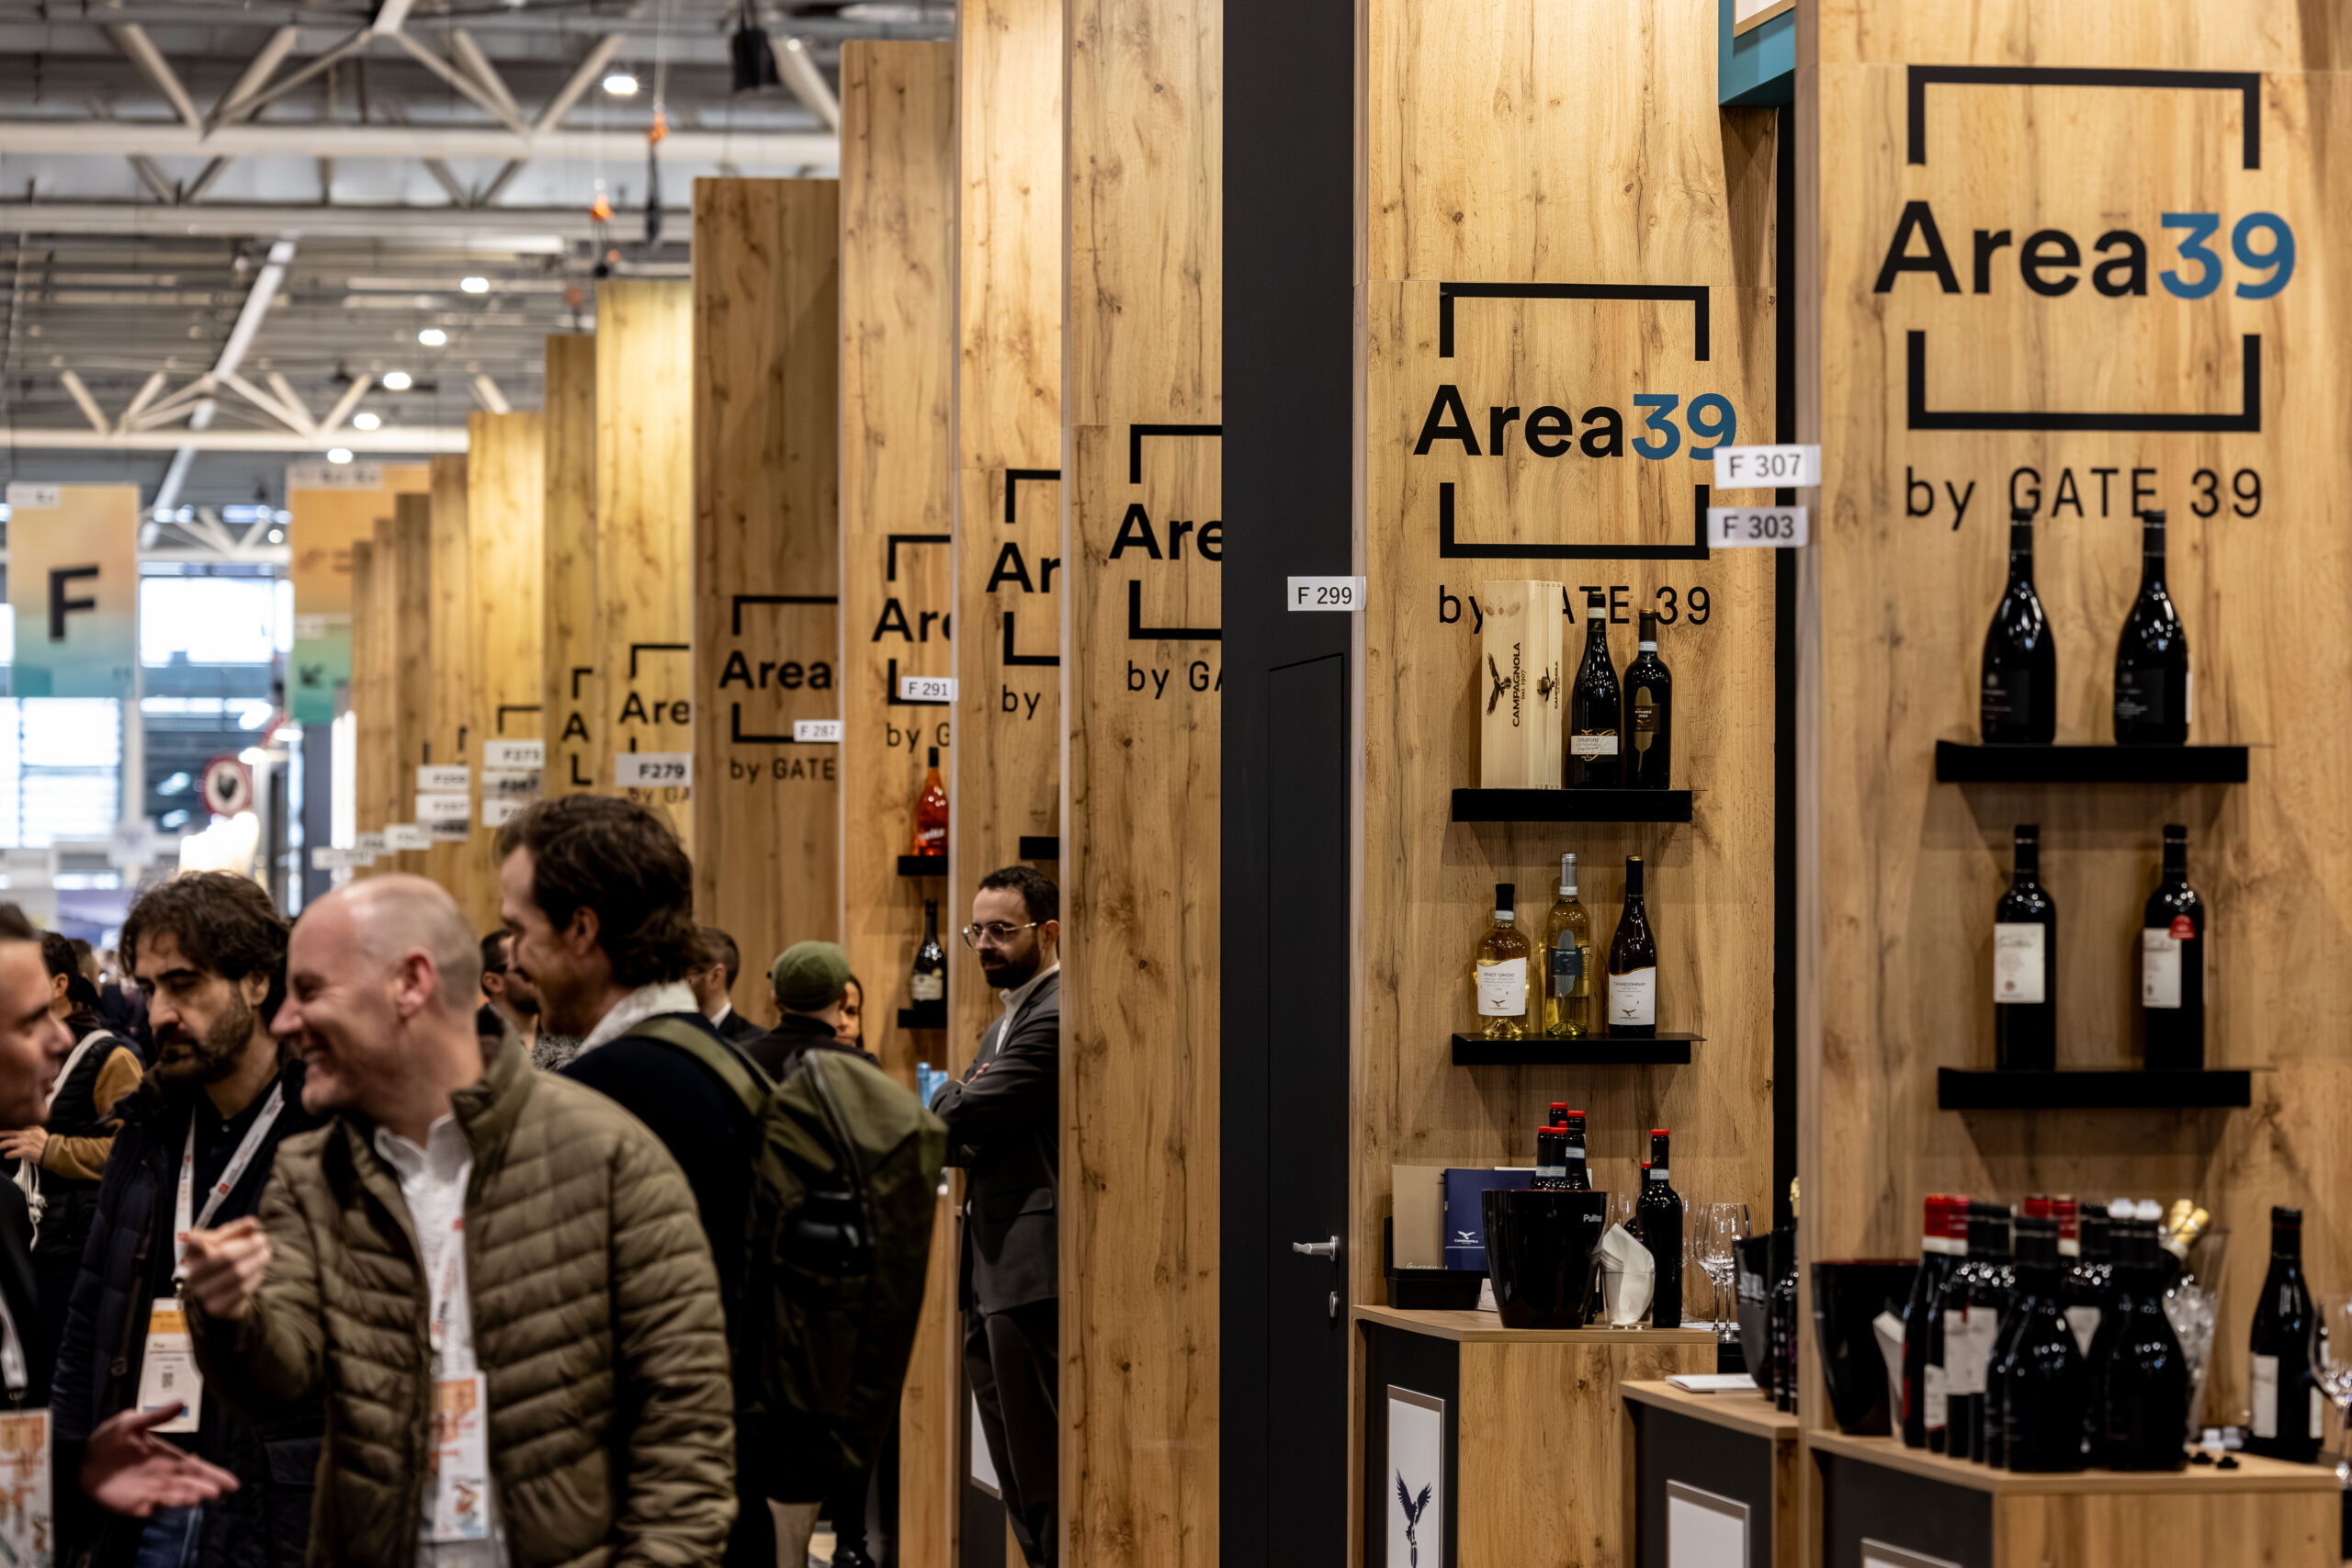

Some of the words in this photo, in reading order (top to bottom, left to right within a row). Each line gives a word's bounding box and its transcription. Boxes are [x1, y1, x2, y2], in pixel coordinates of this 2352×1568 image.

[1872, 200, 2295, 299] Area39
[1413, 385, 1736, 460] Area39
[1729, 456, 1744, 478] F
[1756, 454, 1801, 477] 307
[1906, 466, 1976, 531] by
[2008, 467, 2158, 518] GATE
[2190, 468, 2262, 519] 39
[1723, 515, 1738, 538] F
[1748, 515, 1793, 539] 303
[49, 562, 100, 643] F
[1298, 586, 1310, 604] F
[1317, 586, 1352, 604] 299
[1439, 584, 1483, 635] by
[1656, 586, 1711, 625] 39
[872, 598, 951, 642] Ar
[908, 682, 918, 695] F
[922, 682, 948, 696] 291
[1128, 660, 1170, 700] by
[1512, 642, 1521, 727] CAMPAGNOLA
[1001, 683, 1041, 721] by
[800, 725, 809, 739] F
[813, 725, 836, 739] 287
[887, 721, 921, 754] by
[639, 763, 685, 779] F279
[730, 758, 761, 784] by
[773, 758, 835, 781] GATE
